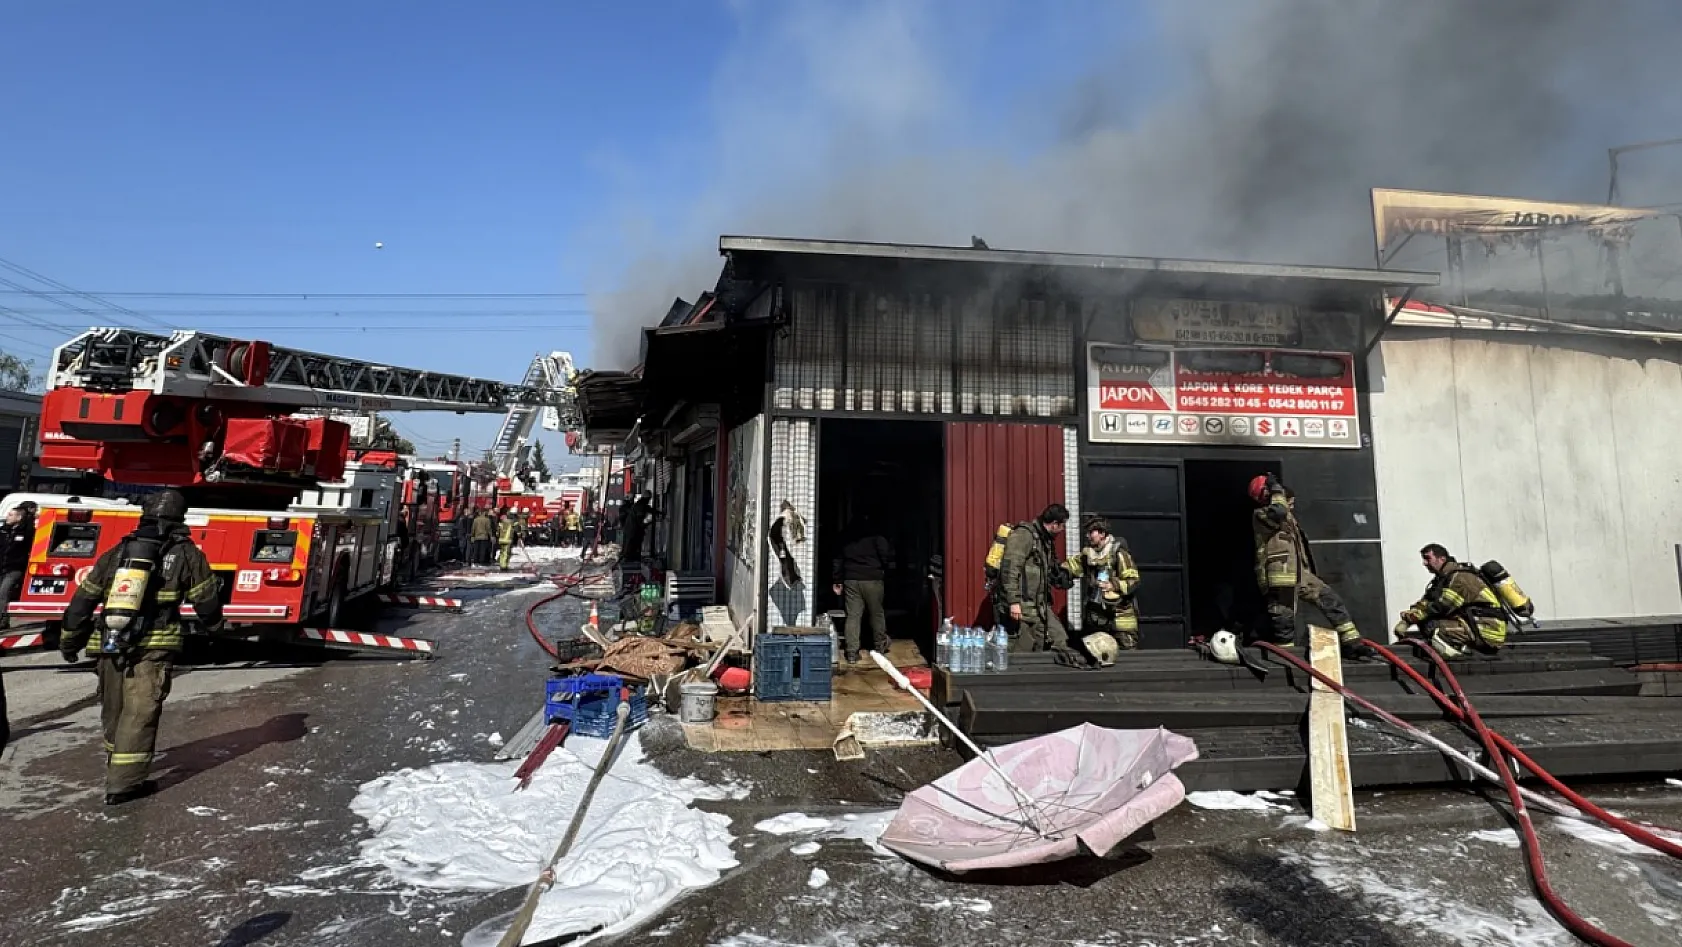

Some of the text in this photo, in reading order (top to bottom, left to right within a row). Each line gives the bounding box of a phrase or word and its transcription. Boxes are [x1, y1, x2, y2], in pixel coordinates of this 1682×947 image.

[1101, 385, 1154, 403] JAPON
[1180, 381, 1218, 393] JAPON
[1235, 383, 1264, 394] KORE
[1268, 384, 1303, 395] YEDEK
[1307, 386, 1344, 398] PARÇA
[1233, 398, 1244, 408] 10
[241, 572, 258, 582] 112
